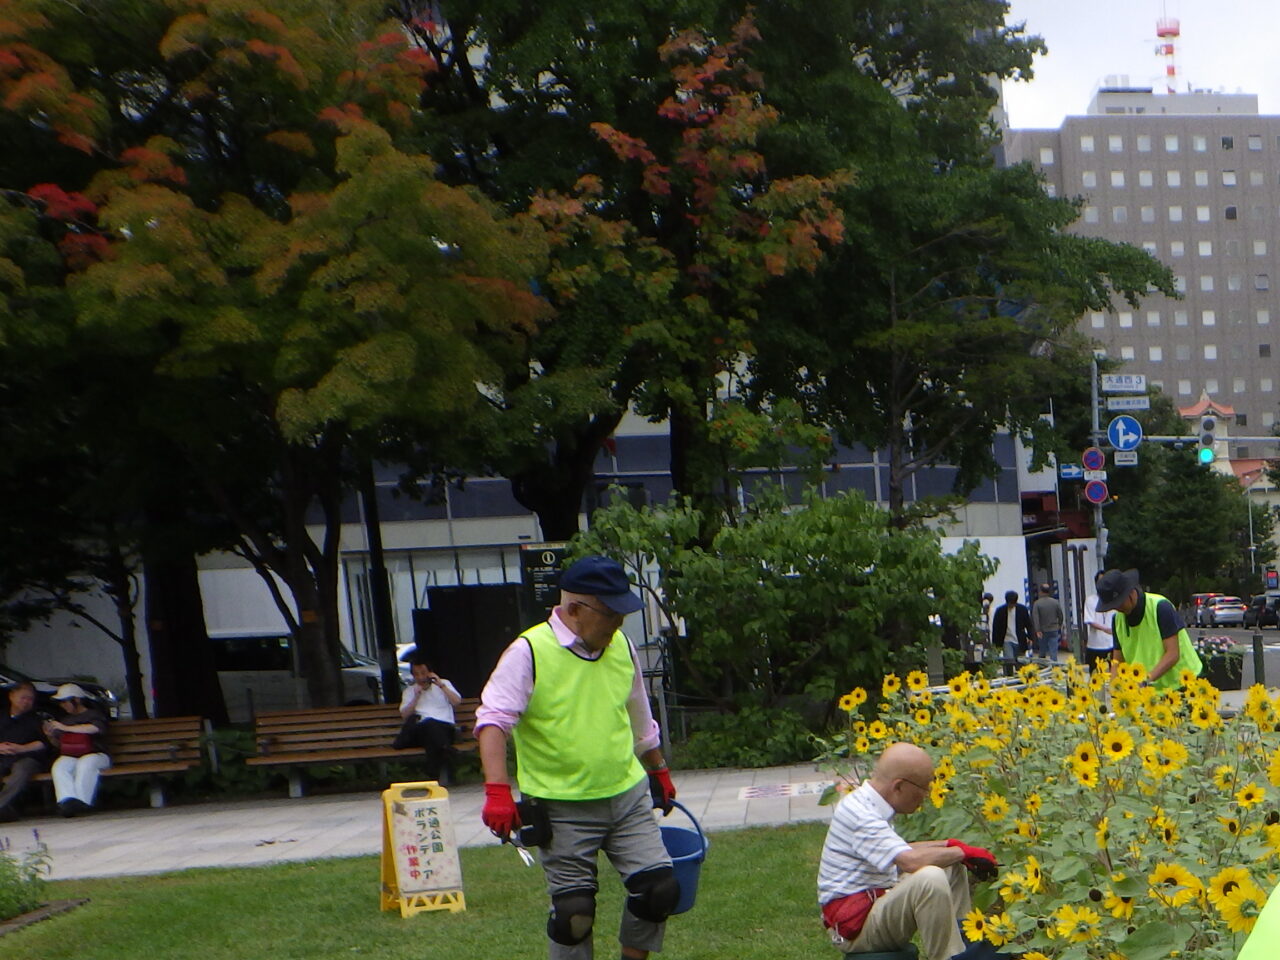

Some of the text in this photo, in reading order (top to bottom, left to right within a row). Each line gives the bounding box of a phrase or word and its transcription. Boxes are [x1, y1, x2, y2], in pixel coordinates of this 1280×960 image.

[414, 808, 434, 880] ボランティア
[426, 807, 444, 853] 大通公園
[405, 844, 421, 880] 作業中
